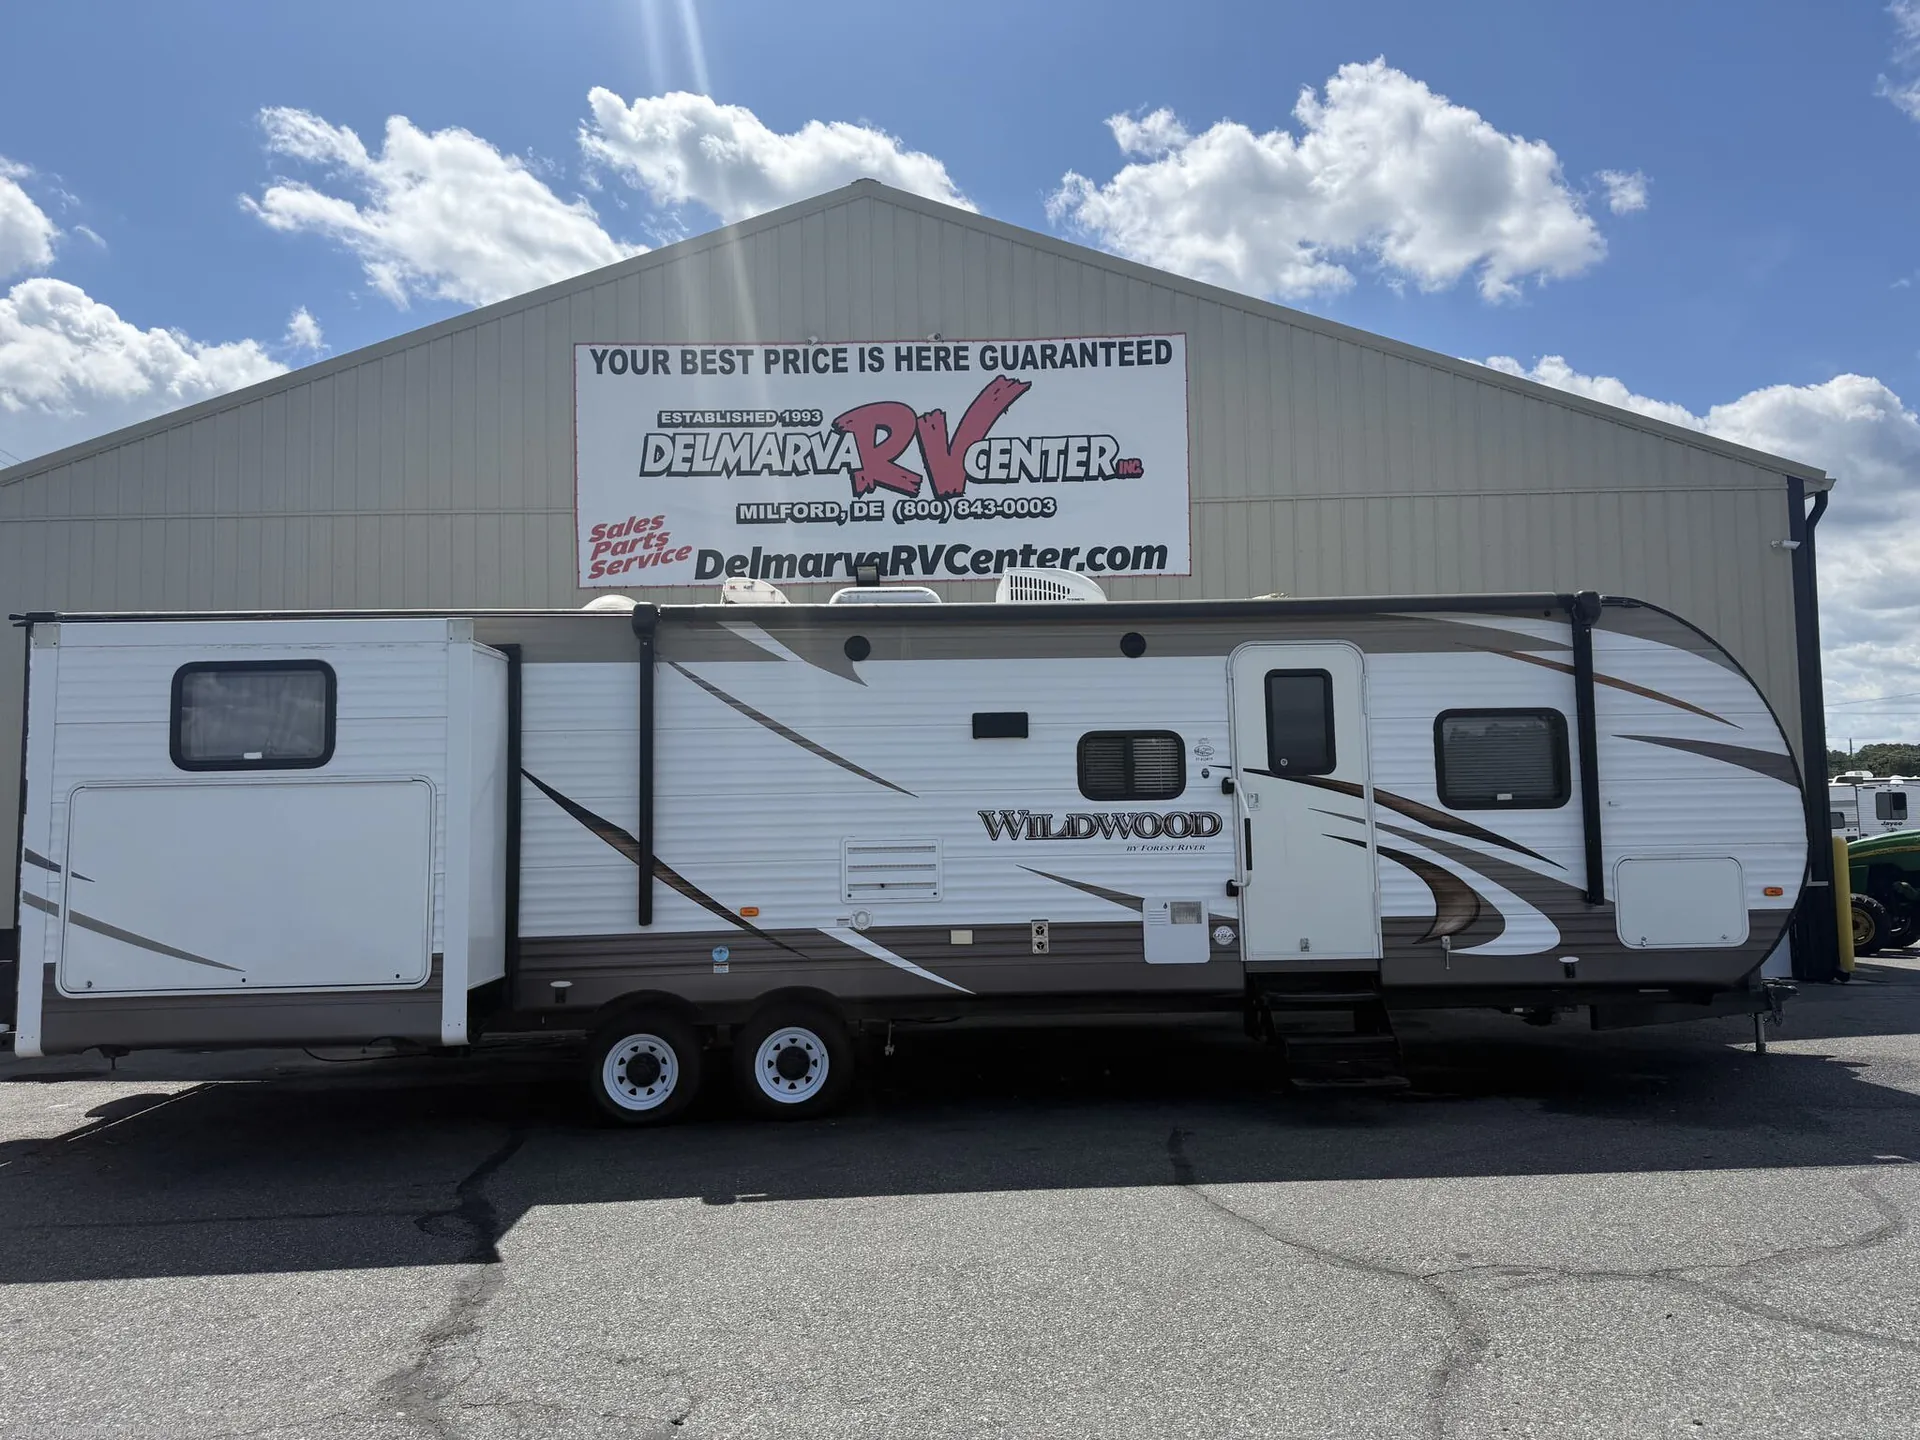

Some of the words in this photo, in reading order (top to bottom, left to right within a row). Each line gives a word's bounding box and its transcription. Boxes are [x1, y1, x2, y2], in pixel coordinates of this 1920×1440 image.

[590, 348, 671, 375] YOUR
[681, 348, 755, 375] BEST
[764, 347, 848, 374] PRICE
[859, 346, 885, 373] IS
[895, 345, 970, 372] HERE
[979, 339, 1173, 371] GUARANTEED
[658, 411, 777, 427] ESTABLISHED
[780, 410, 822, 427] 1993
[640, 431, 863, 478] DELMARVA
[831, 374, 1032, 499] RV
[963, 434, 1119, 483] CENTER
[737, 502, 847, 525] MILFORD,
[850, 501, 884, 522] DE
[893, 498, 952, 524] (800)
[953, 497, 1056, 521] 843-0003
[589, 514, 666, 543] Sales
[589, 532, 671, 561] Parts
[694, 543, 1168, 580] DelmarvaRVCenter.com
[588, 545, 693, 580] Service
[978, 810, 1223, 841] WILDWOOD
[1141, 844, 1175, 852] FOREST
[1177, 843, 1206, 851] RIVER
